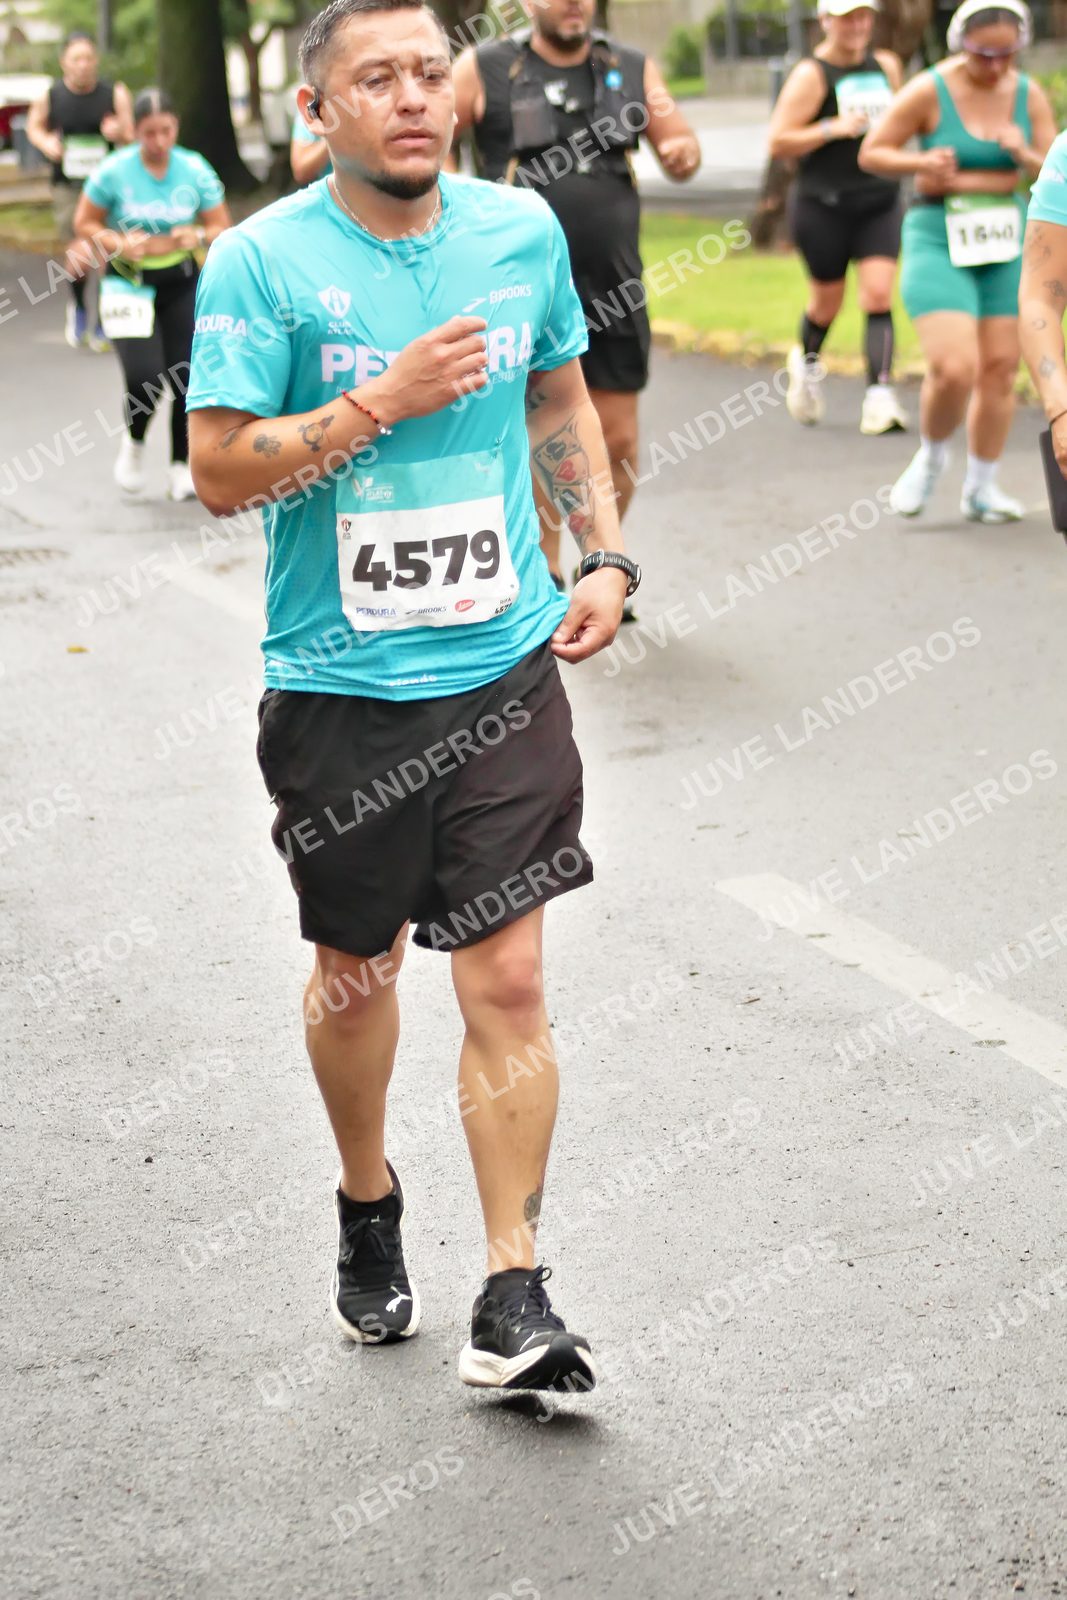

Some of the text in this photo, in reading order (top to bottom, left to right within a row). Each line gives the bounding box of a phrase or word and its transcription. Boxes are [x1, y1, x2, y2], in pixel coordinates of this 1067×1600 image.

[489, 284, 532, 304] BROOKS
[353, 529, 500, 591] 4579
[417, 606, 447, 615] BROOKS
